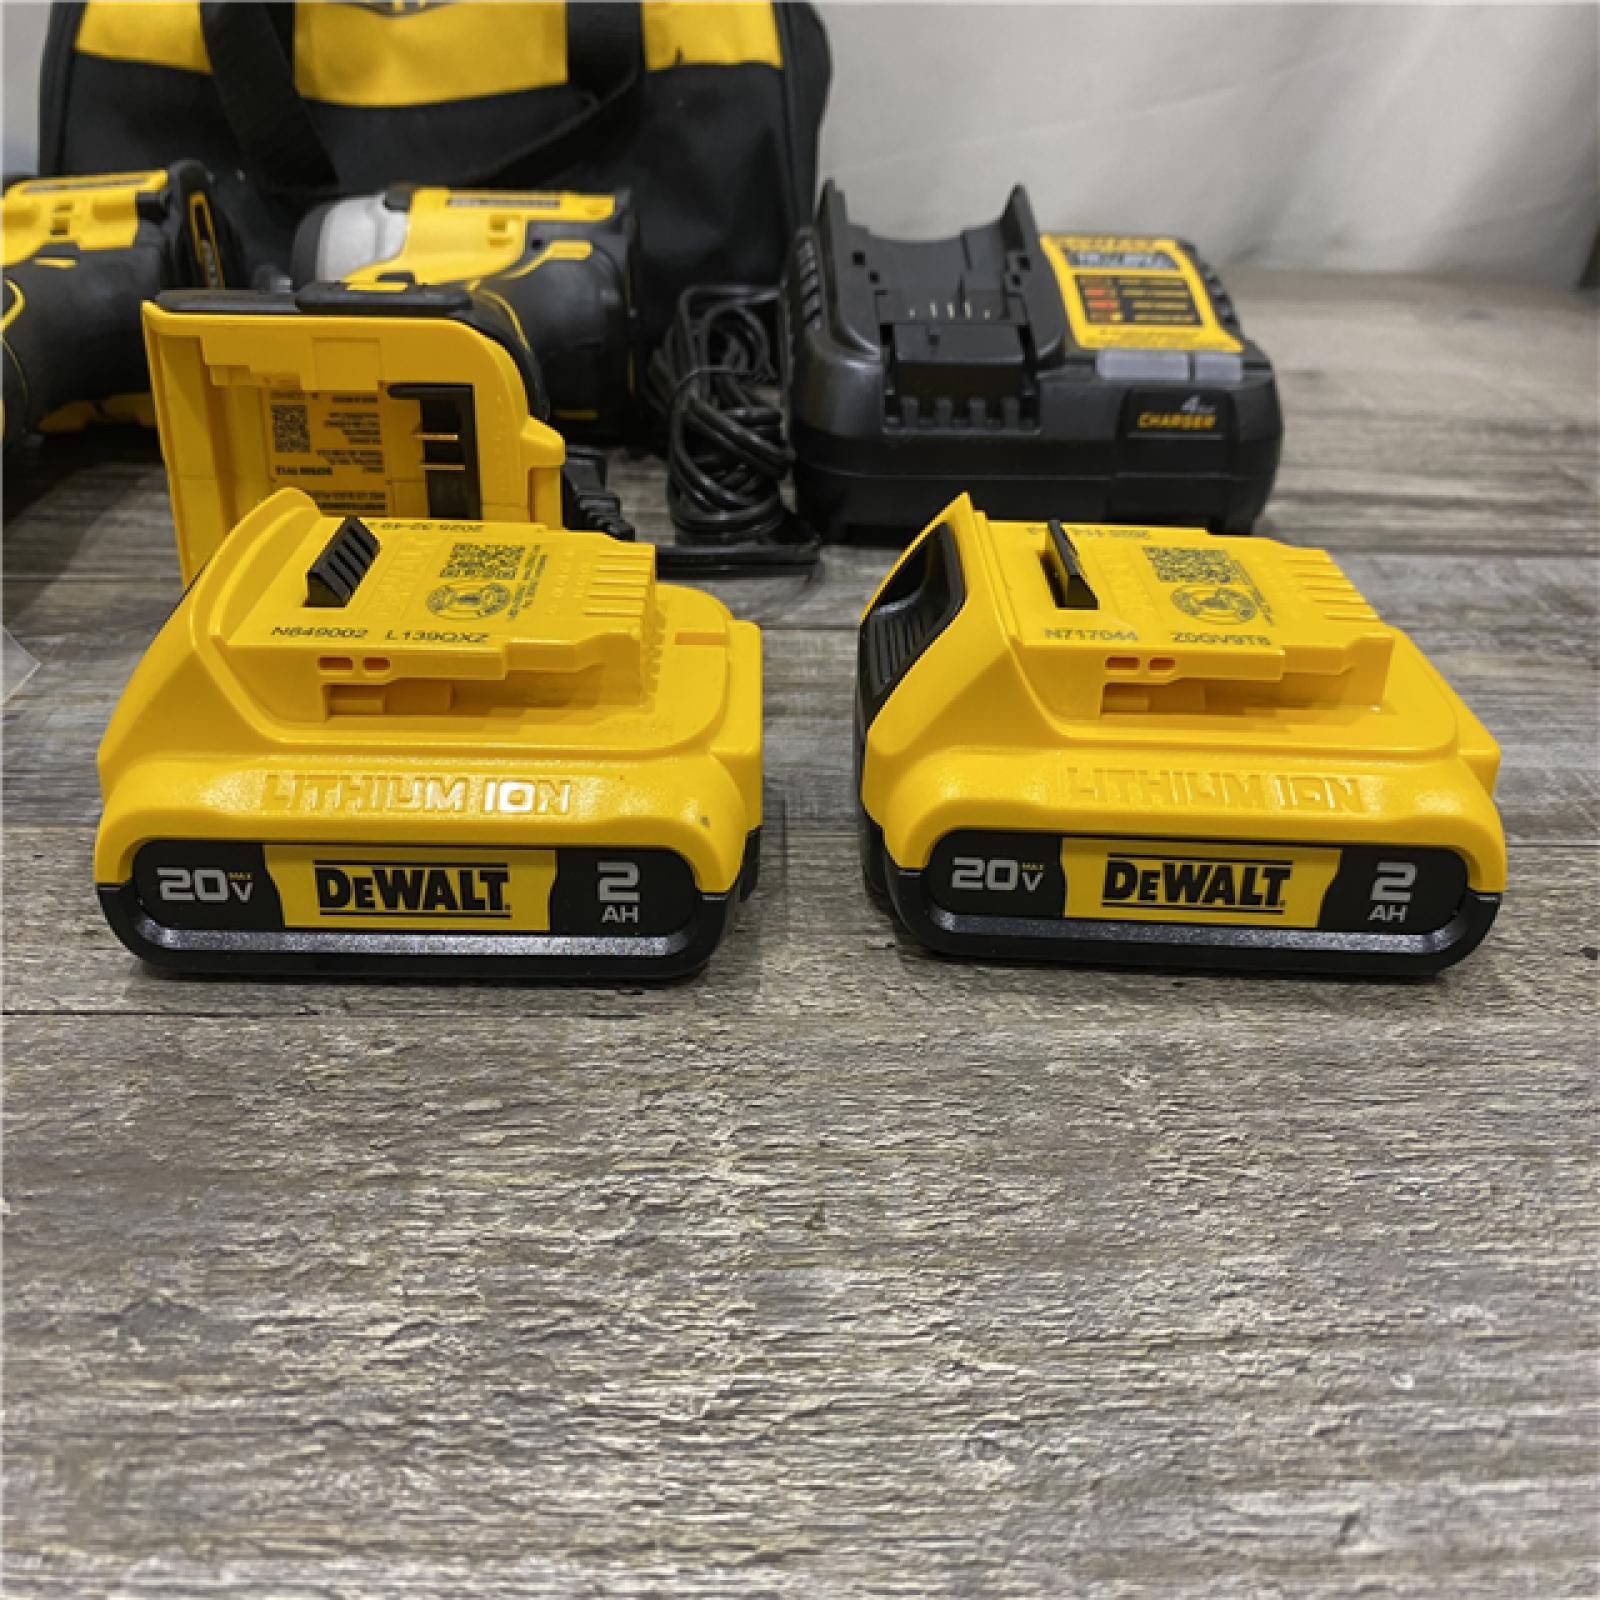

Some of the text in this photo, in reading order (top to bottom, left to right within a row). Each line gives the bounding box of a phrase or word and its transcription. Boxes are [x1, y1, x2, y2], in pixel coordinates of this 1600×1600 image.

[1137, 412, 1217, 429] CHARGER
[262, 774, 570, 815] LITHIUM ION
[1067, 767, 1365, 813] LITHIUM ION
[597, 861, 640, 903] 2
[1371, 861, 1416, 901] 2
[601, 904, 639, 924] AH
[1368, 905, 1407, 924] AH
